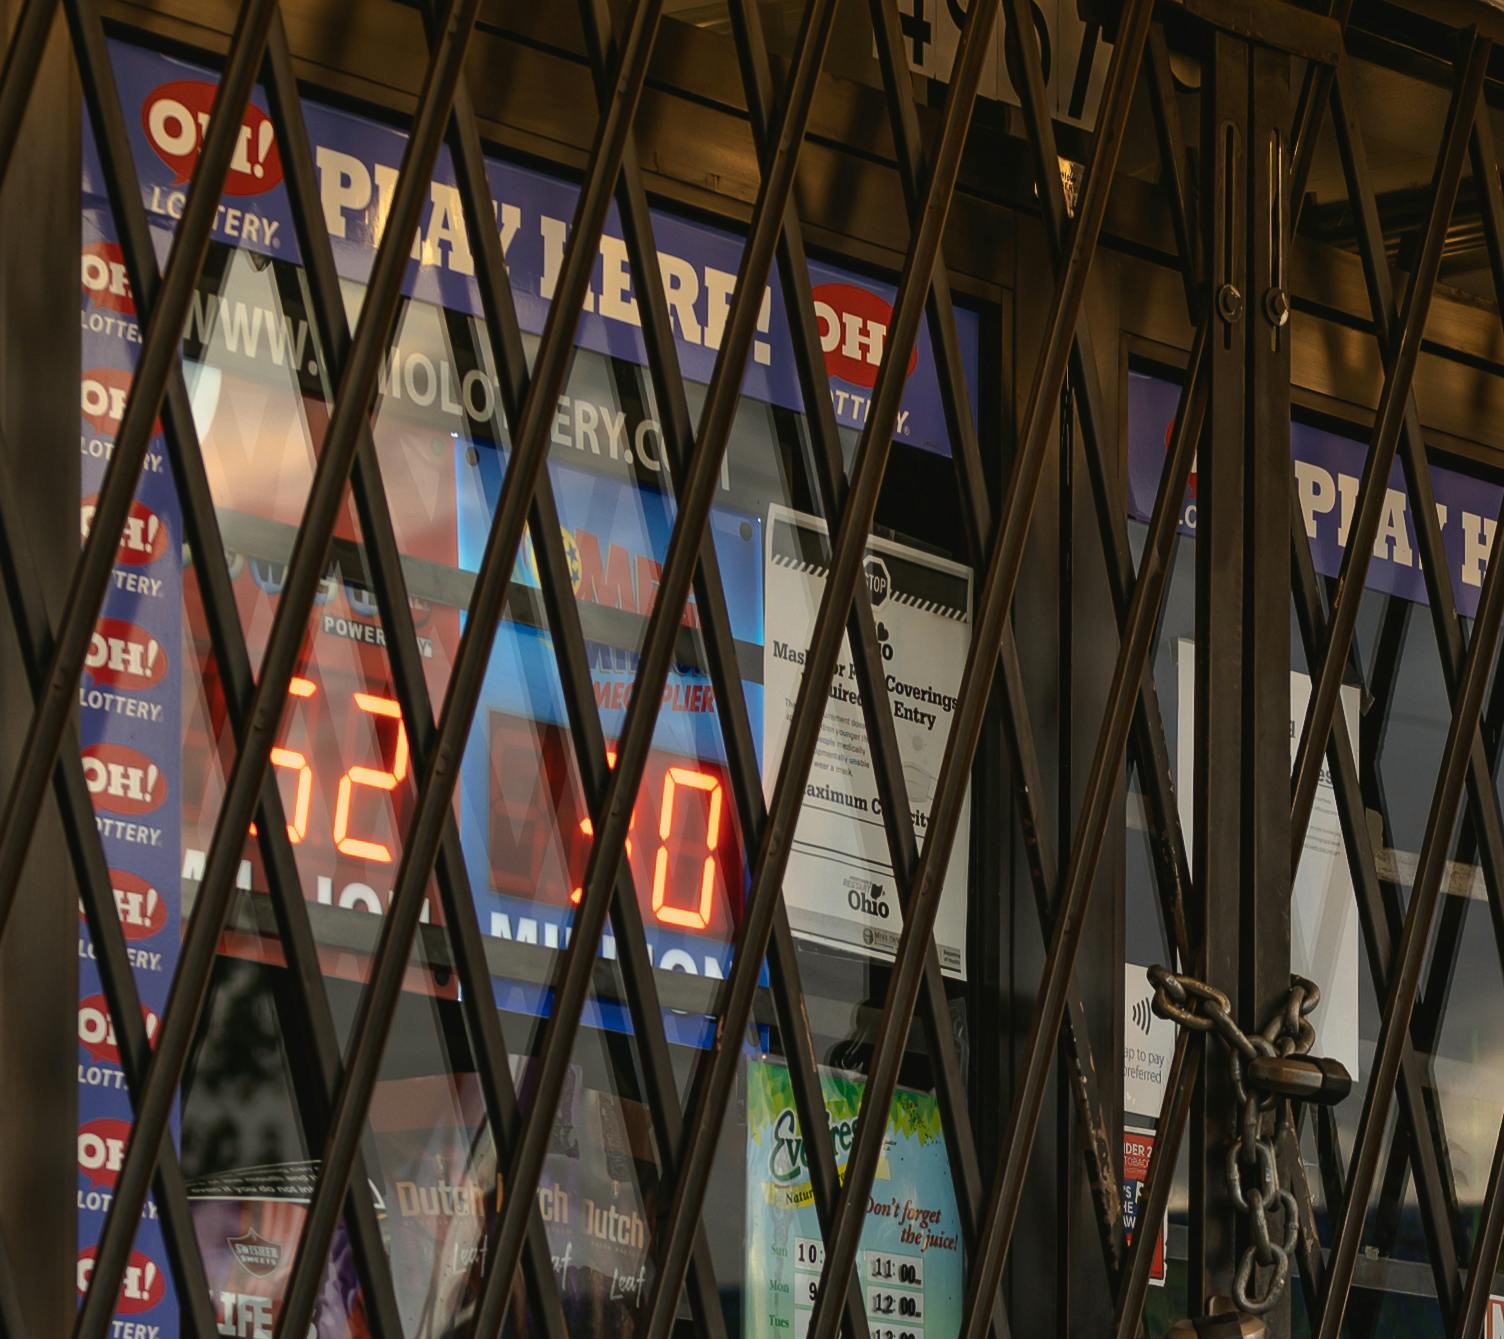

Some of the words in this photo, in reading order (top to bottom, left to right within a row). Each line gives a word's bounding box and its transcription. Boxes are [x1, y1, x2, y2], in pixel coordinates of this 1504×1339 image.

[541, 216, 771, 366] HERE!
[1295, 460, 1447, 571] PLA
[85, 632, 158, 678] OH!
[80, 688, 162, 721] LOTTERY
[886, 675, 958, 712] Coverings
[894, 701, 936, 730] Entry
[81, 757, 158, 803] OH!
[804, 784, 869, 813] aximum
[95, 818, 161, 846] OTTERY
[848, 890, 889, 919] Ohio
[1147, 1052, 1166, 1069] pay
[396, 1179, 484, 1218] Dutch
[898, 1200, 943, 1229] forget
[900, 1225, 921, 1245] the
[920, 1231, 958, 1253] juice!
[769, 1313, 790, 1329] Tues
